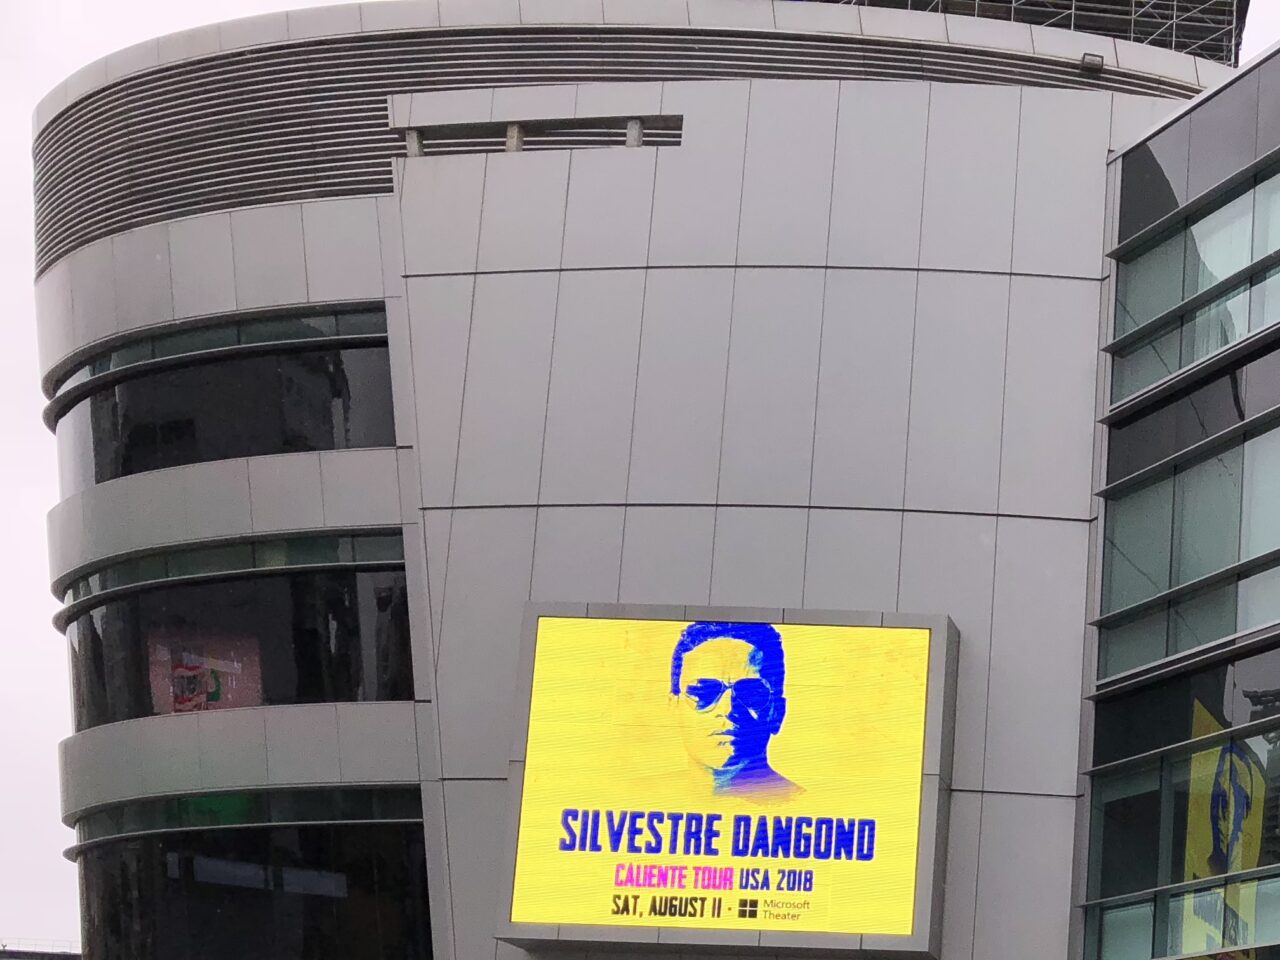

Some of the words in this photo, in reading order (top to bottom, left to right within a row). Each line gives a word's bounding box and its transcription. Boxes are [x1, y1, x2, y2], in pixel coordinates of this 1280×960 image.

[558, 808, 722, 856] SILVESTRE
[731, 814, 876, 861] DANGOND
[614, 863, 688, 889] CALIENTE
[692, 866, 734, 890] TOUR
[739, 868, 770, 891] USA
[776, 869, 814, 892] 2018
[611, 894, 643, 918] SAT,
[648, 895, 708, 919] AUGUST
[762, 909, 801, 921] Theater
[763, 899, 811, 910] Microsoft
